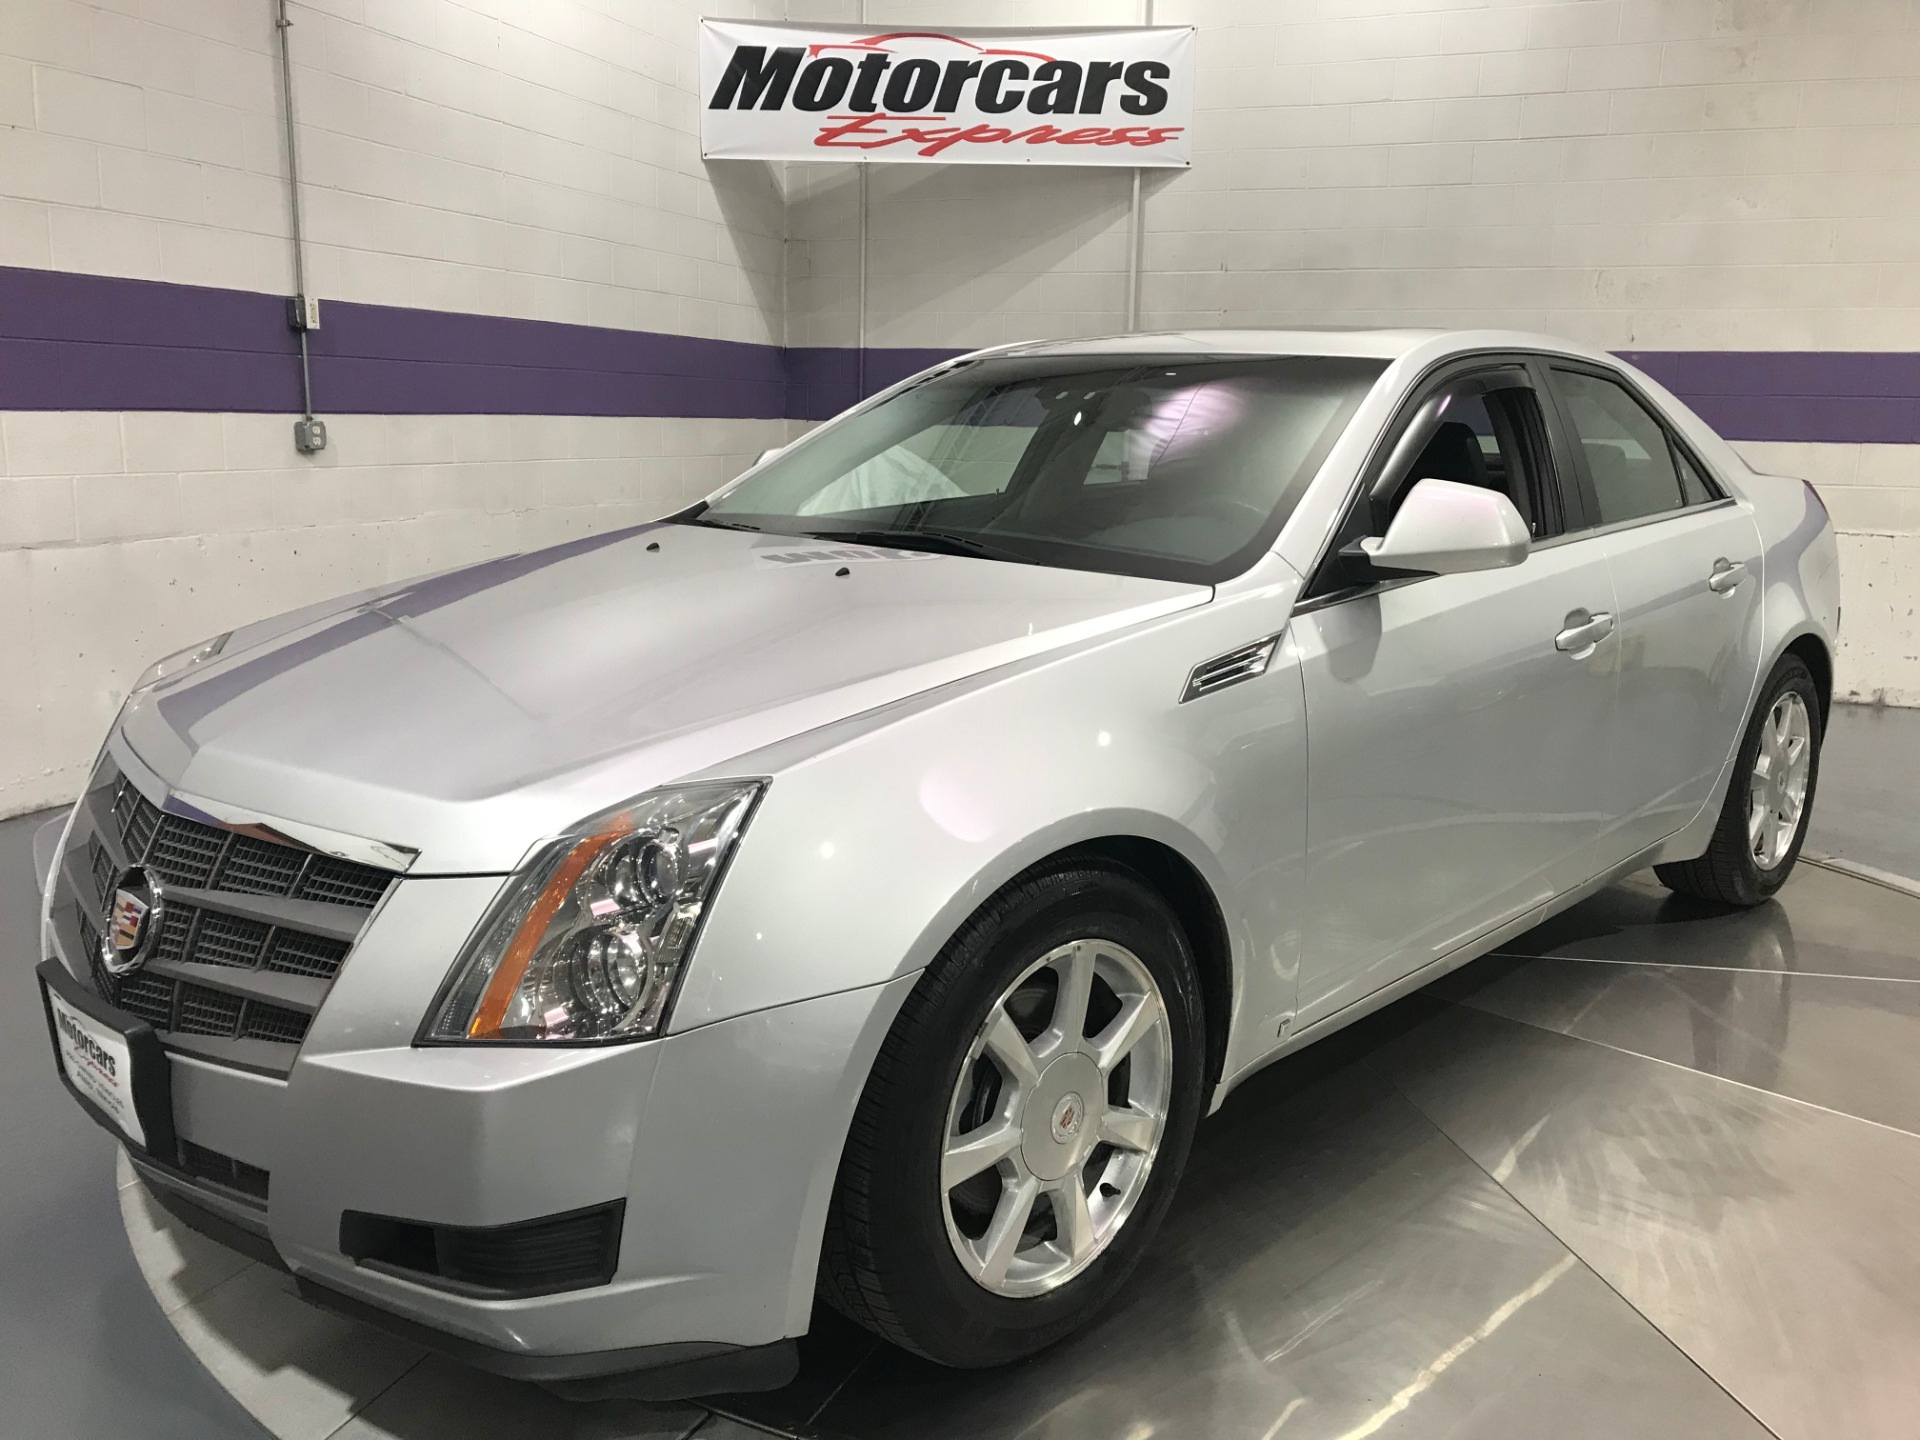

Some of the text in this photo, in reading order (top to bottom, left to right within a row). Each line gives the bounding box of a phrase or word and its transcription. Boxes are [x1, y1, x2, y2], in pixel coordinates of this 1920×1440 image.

[708, 45, 1170, 115] Motorcars
[813, 112, 1185, 156] Express
[57, 1008, 116, 1076] Motorcars
